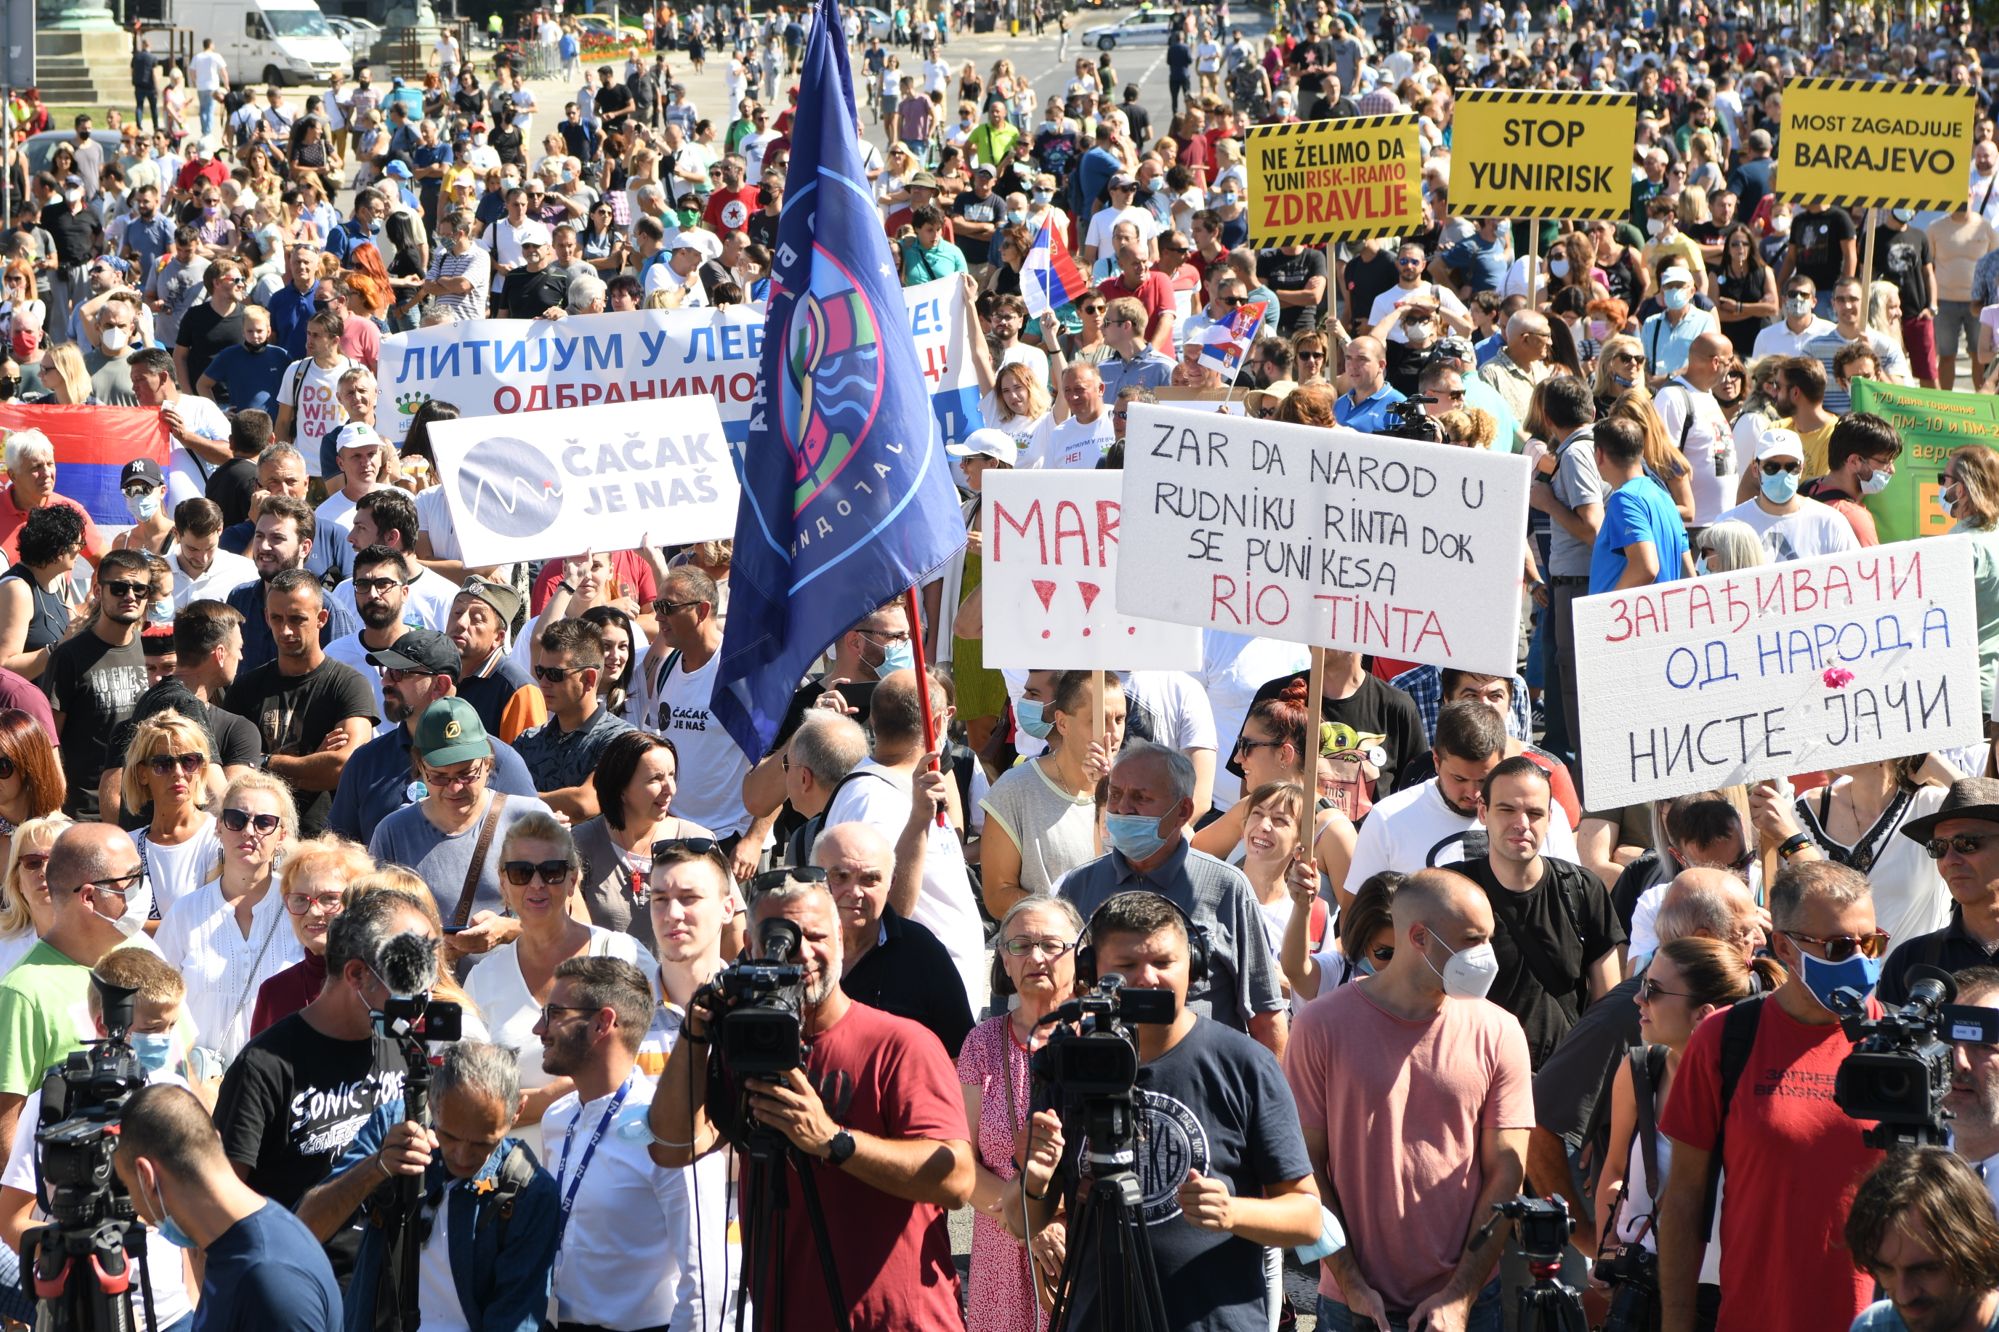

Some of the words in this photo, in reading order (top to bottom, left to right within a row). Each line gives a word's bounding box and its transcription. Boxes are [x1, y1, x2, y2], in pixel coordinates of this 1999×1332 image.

[1503, 118, 1585, 147] STOP
[1791, 114, 1846, 132] MOST
[1851, 117, 1962, 138] ZAGADJUJE
[1262, 148, 1288, 171] NE
[1294, 139, 1370, 168] ŽELIMO
[1378, 138, 1405, 161] DA
[1794, 142, 1955, 175] BARAJEVO
[1264, 162, 1406, 192] YUNIRISK-IRAMO
[1469, 161, 1614, 193] YUNIRISK
[1263, 184, 1409, 228] ZDRAVLJE
[396, 333, 624, 384] ЛИТИЈУМ
[639, 330, 667, 368] У
[562, 432, 718, 477] ČAČAK
[1151, 424, 1229, 468] ZAR
[1252, 439, 1285, 476] DA
[1310, 449, 1437, 498] NAROD
[1461, 478, 1484, 509] U
[583, 484, 629, 515] JE
[634, 467, 719, 511] NAŠ
[1187, 529, 1224, 562] SE
[1321, 547, 1396, 596] KESA
[1422, 526, 1475, 564] DOK
[1605, 551, 1923, 642] ЗАГАЂИВАЧИ
[1665, 640, 1739, 690] ОД
[1757, 607, 1951, 676] НАРОДА
[672, 706, 709, 720] ČAČAK
[674, 720, 683, 729] JE
[685, 719, 705, 731] NAŠ
[1629, 707, 1792, 782] НИСТЕ
[1824, 675, 1951, 746] ЈАЧИ
